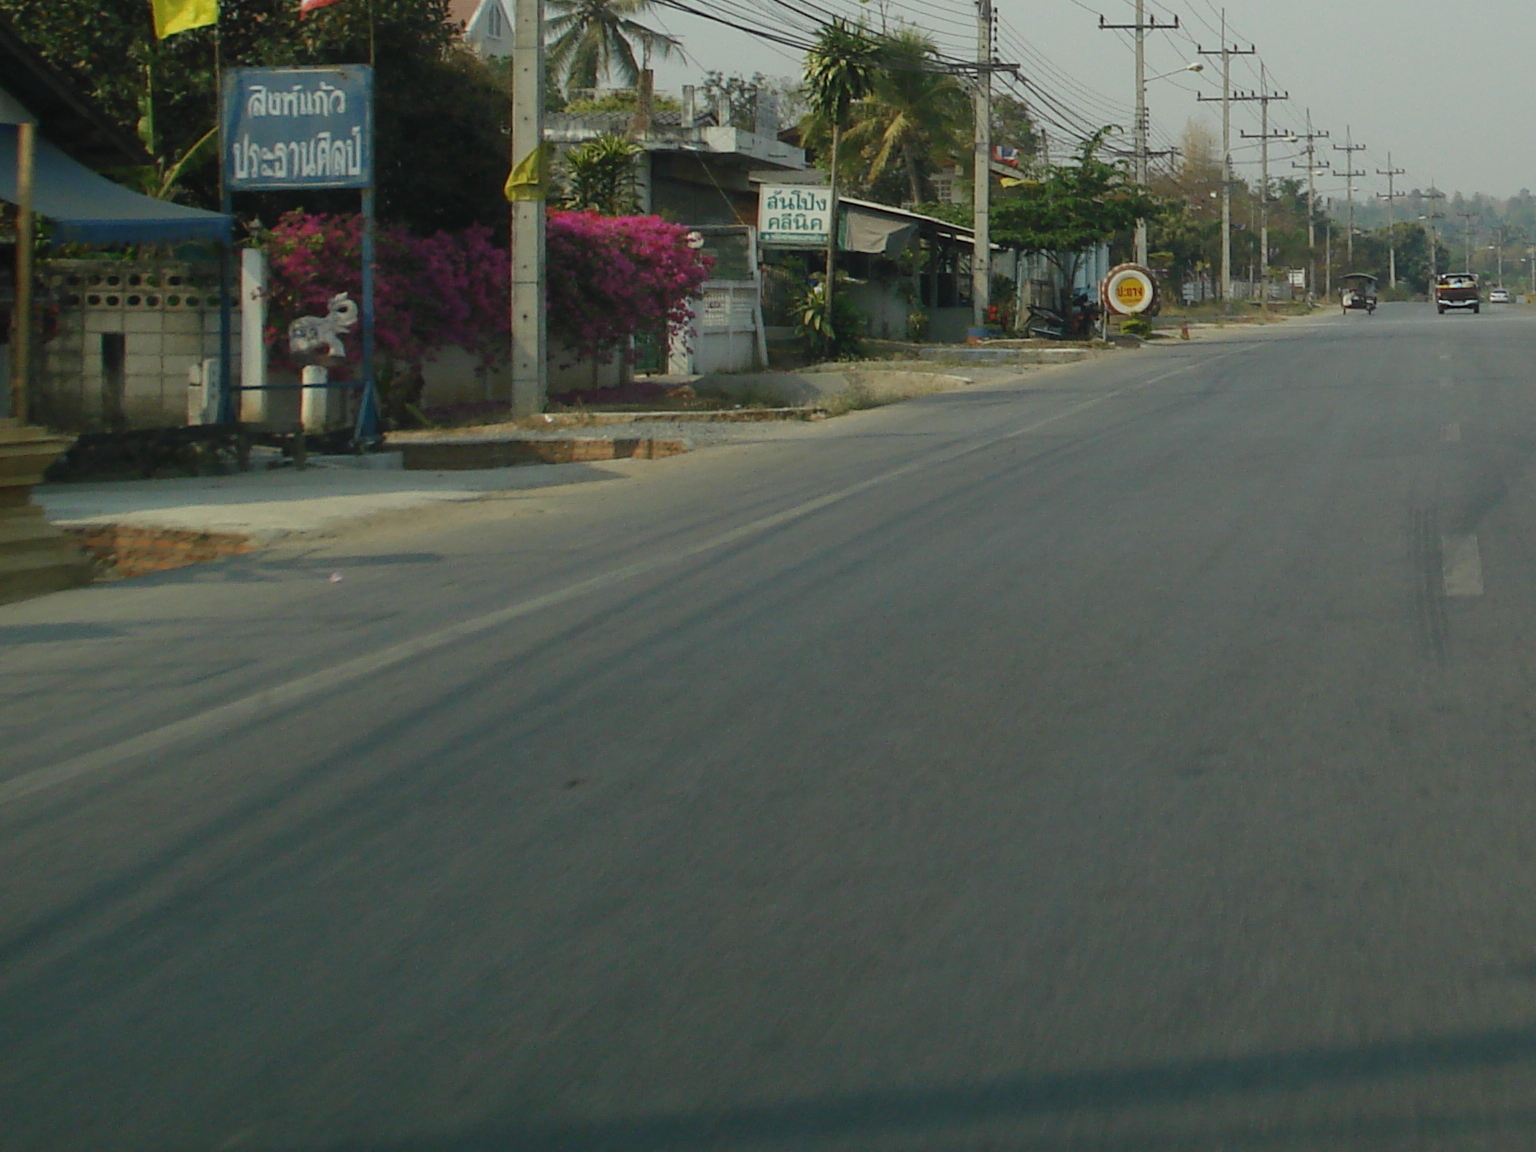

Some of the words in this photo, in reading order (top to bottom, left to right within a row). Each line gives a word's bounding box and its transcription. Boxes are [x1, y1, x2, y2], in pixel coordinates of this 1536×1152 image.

[232, 126, 361, 179] ประธานศิลป์
[767, 190, 827, 211] สันโป่ง
